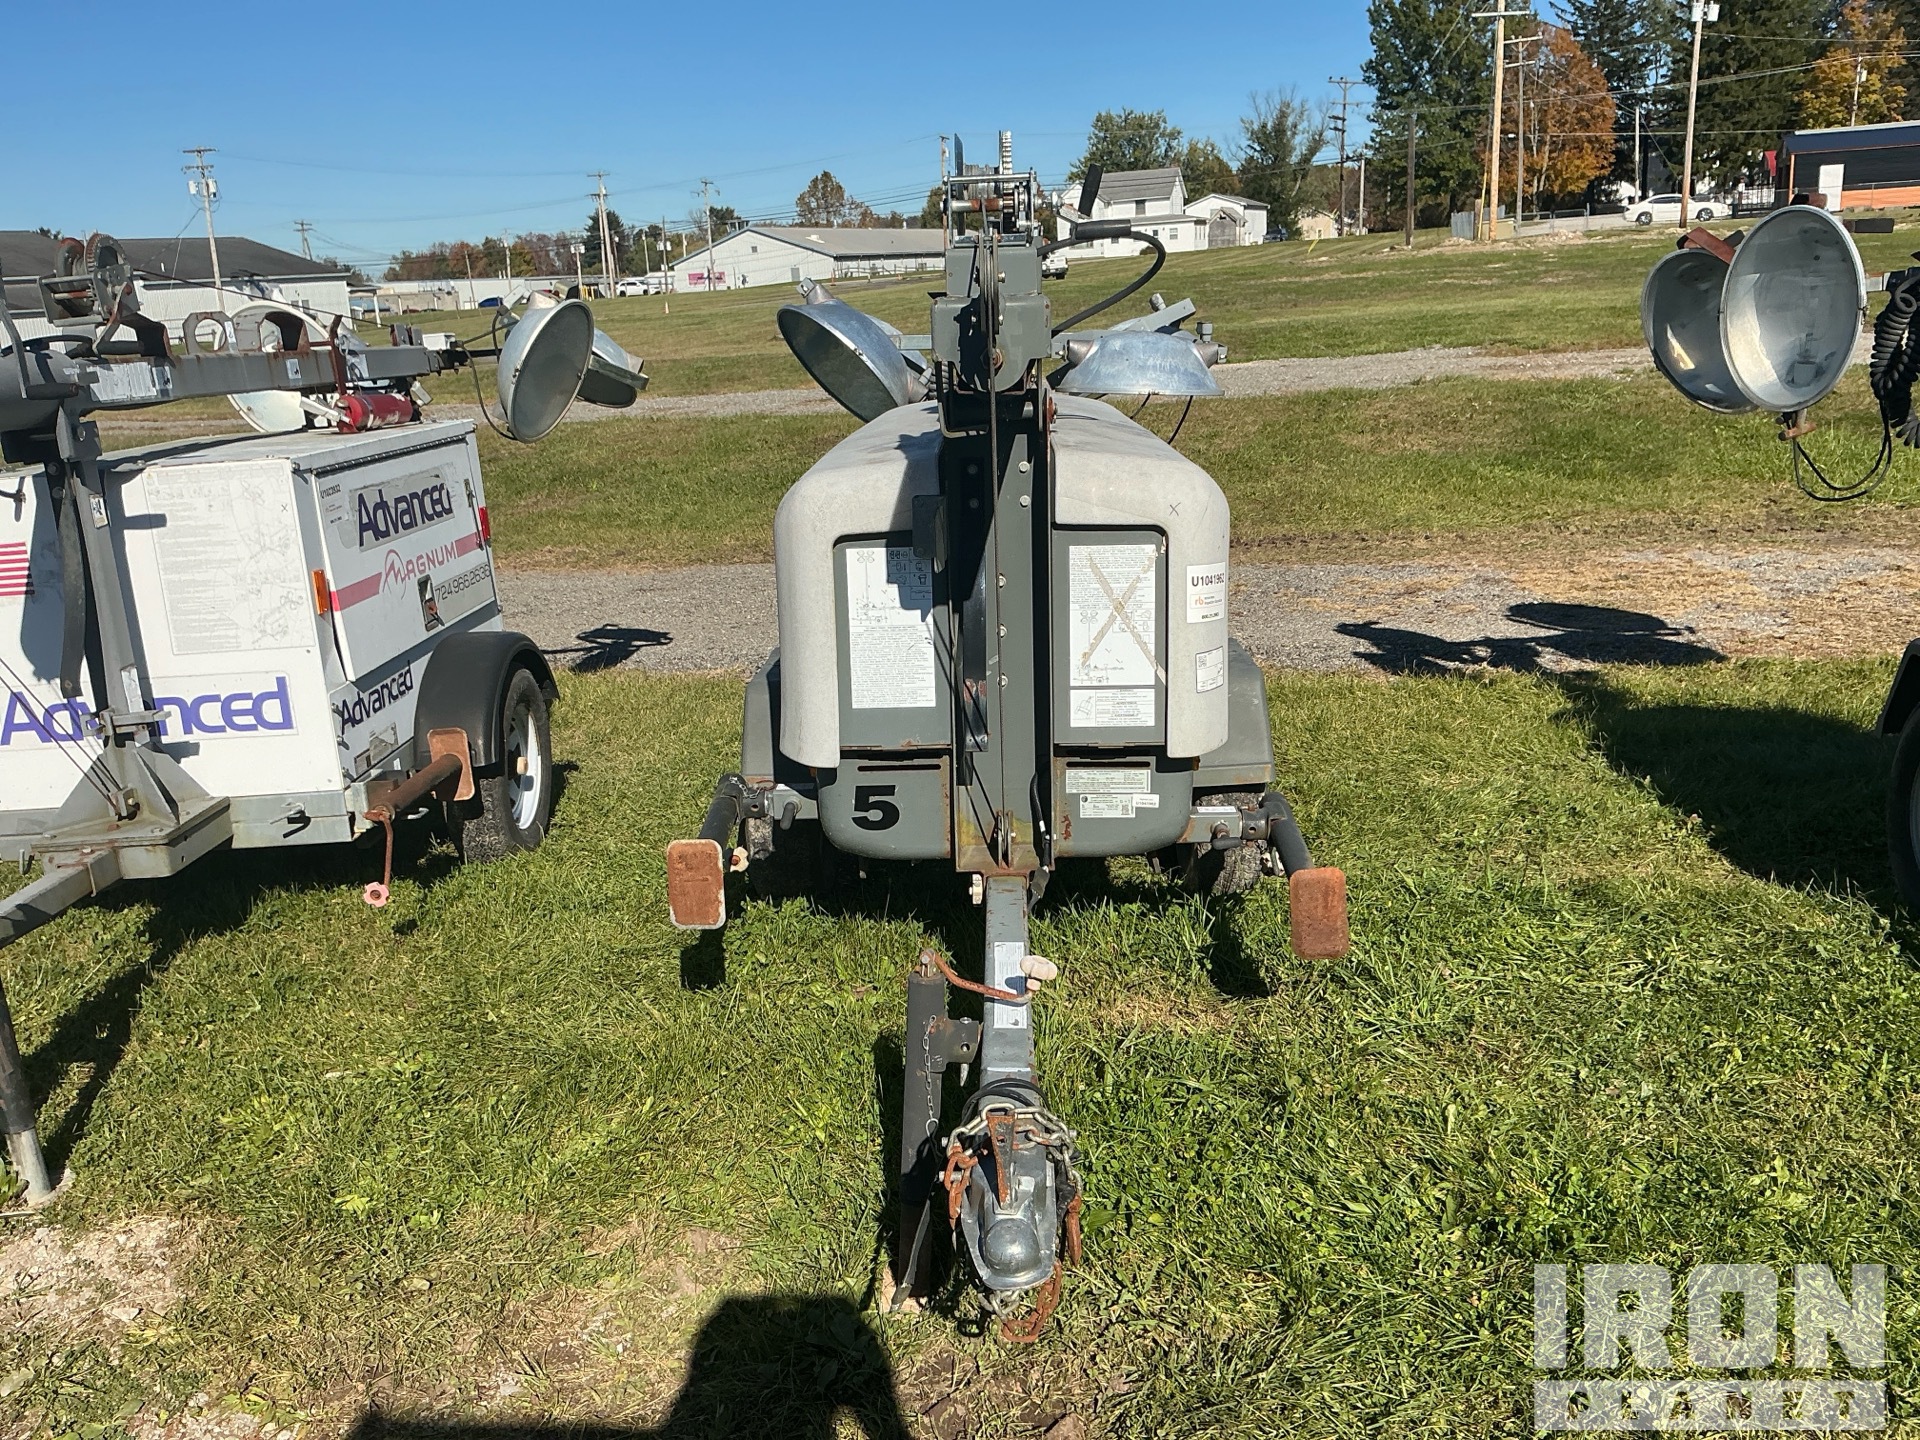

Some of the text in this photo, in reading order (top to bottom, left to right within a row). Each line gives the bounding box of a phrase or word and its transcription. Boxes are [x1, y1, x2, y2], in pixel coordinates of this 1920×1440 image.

[358, 483, 453, 547] Advanced
[382, 541, 457, 593] MAGNUM
[341, 659, 414, 735] Advanced
[851, 784, 900, 831] 5
